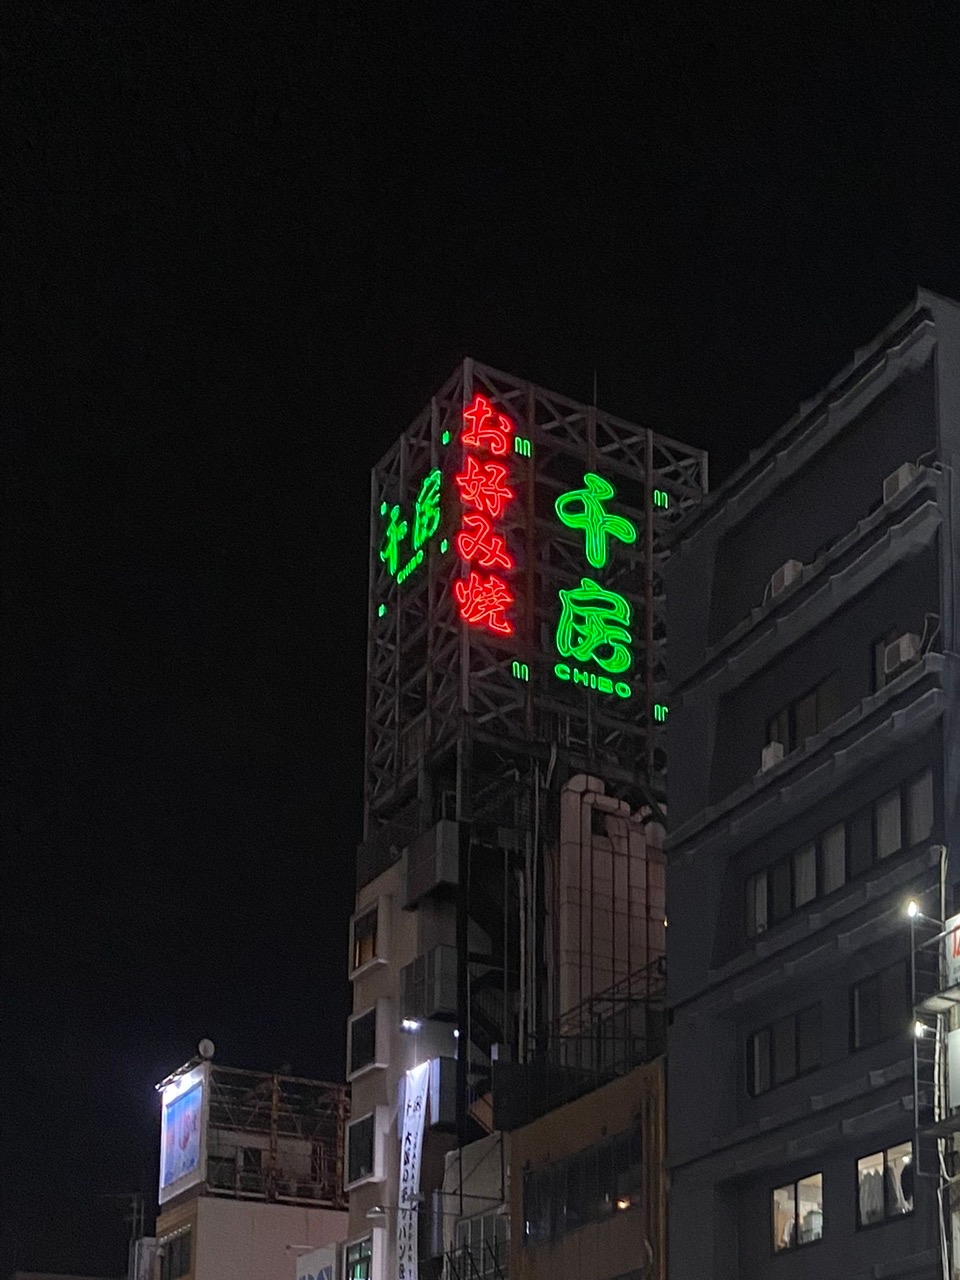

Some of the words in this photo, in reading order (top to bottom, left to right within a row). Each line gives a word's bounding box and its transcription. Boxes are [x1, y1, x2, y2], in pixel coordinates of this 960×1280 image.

[455, 396, 513, 635] お好み焼
[554, 473, 636, 673] 千房
[554, 664, 632, 698] CHIBO
